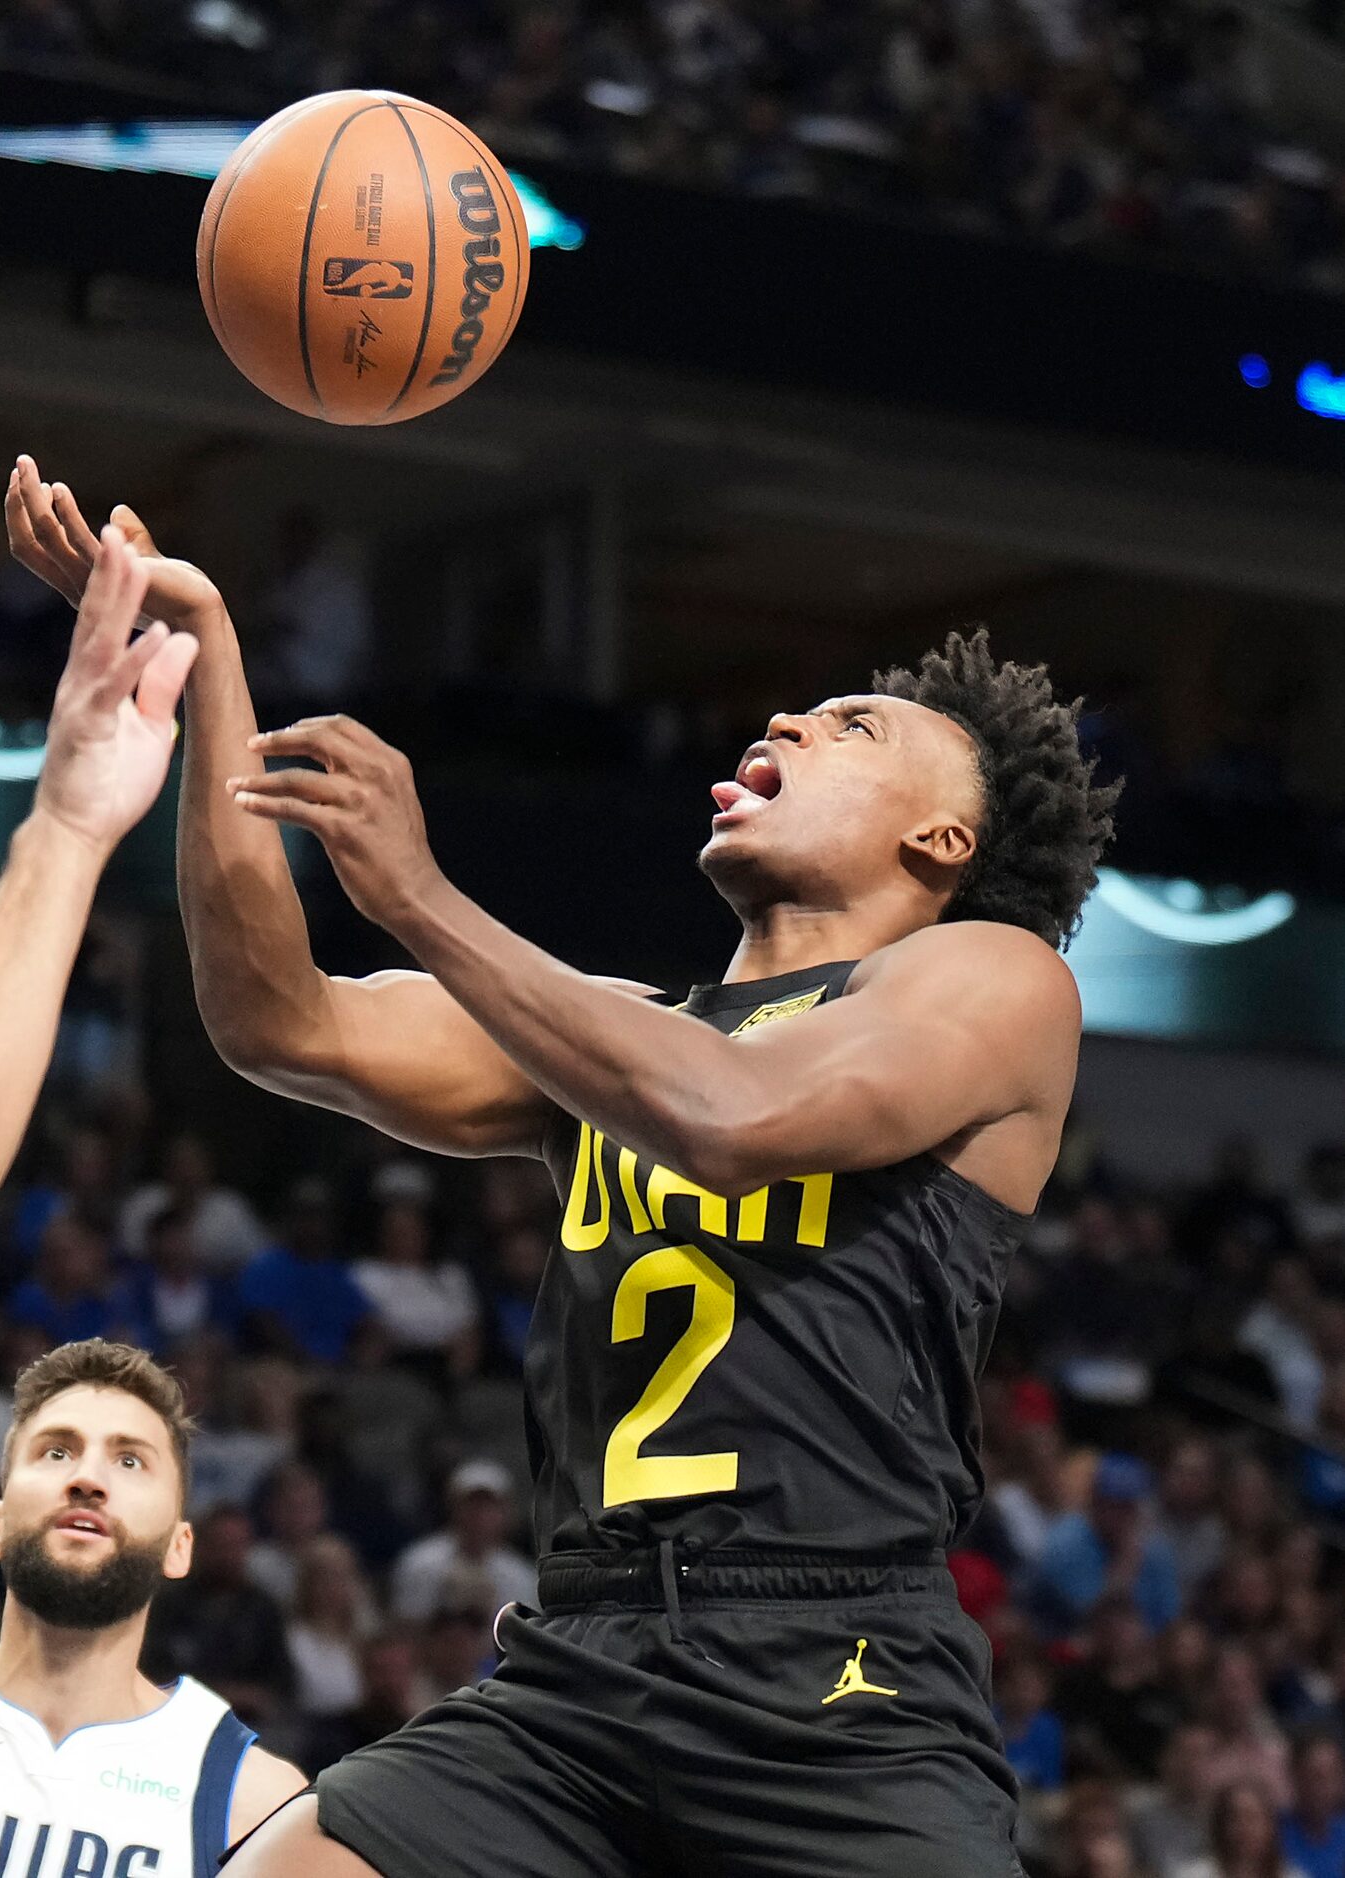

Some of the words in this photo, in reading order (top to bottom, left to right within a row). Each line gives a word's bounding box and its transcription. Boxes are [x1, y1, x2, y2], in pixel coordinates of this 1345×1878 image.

[428, 164, 505, 388] Wilson
[602, 1244, 738, 1509] 2
[99, 1766, 180, 1802] chime
